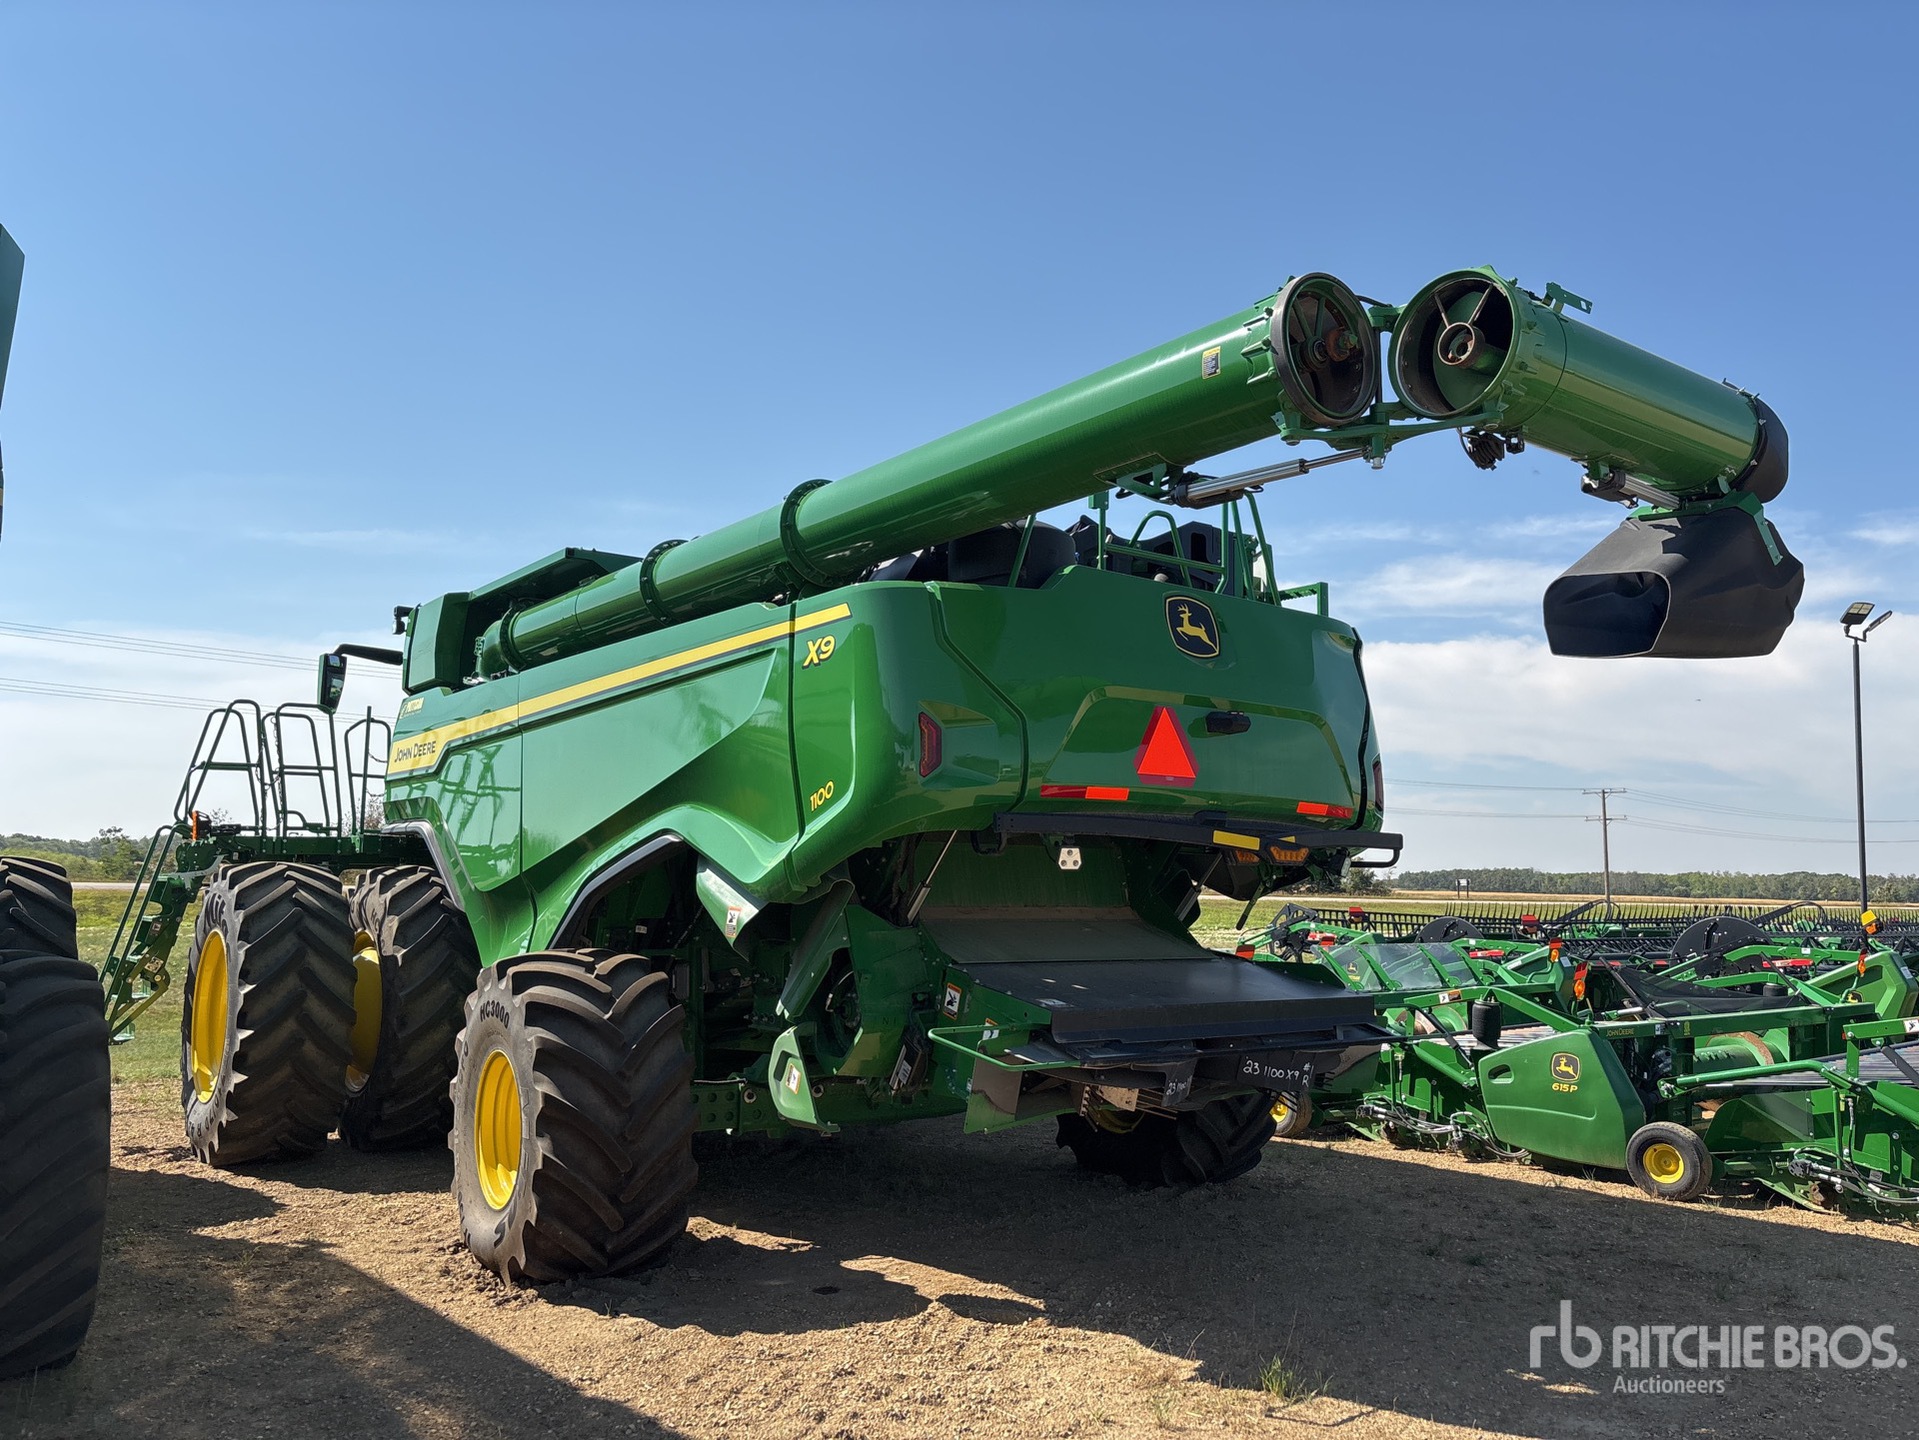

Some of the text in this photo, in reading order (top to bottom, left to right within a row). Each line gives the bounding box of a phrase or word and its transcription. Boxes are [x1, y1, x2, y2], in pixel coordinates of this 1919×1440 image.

[802, 635, 836, 669] X9
[394, 740, 437, 763] JOHN DEERE
[810, 780, 834, 812] 1100
[480, 999, 510, 1030] HC3000
[1551, 1082, 1579, 1093] 615P
